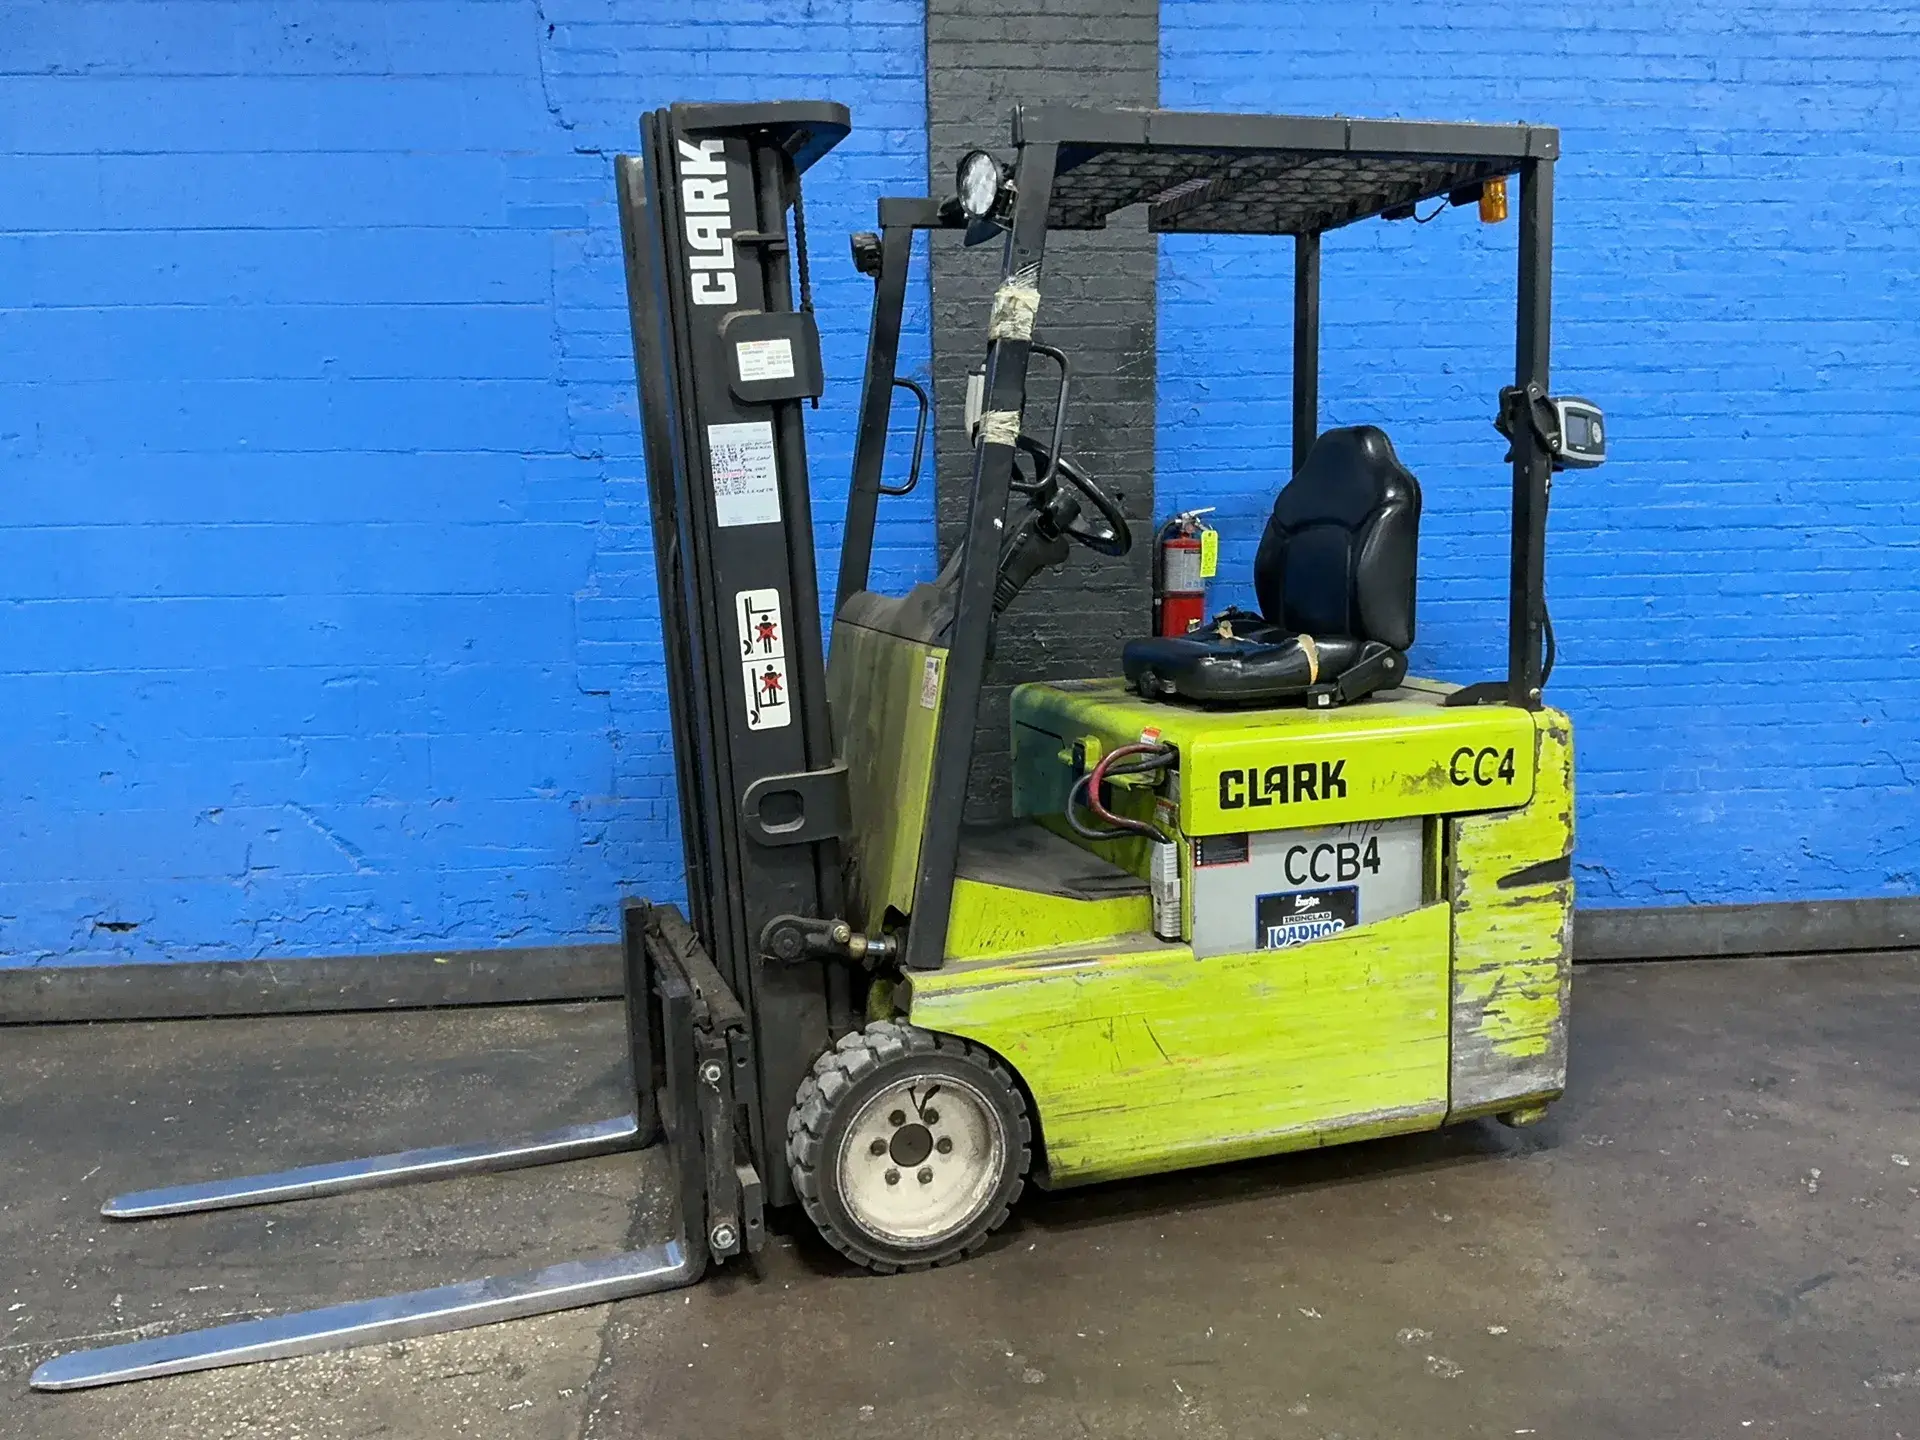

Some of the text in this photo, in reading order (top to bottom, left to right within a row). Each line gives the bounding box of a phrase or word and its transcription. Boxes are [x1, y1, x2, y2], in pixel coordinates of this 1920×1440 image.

[678, 139, 738, 305] CLARK
[1219, 759, 1347, 810] CLARK
[1450, 746, 1516, 787] CC4
[1284, 835, 1381, 885] CCB4
[1284, 911, 1331, 923] IRONCLAD
